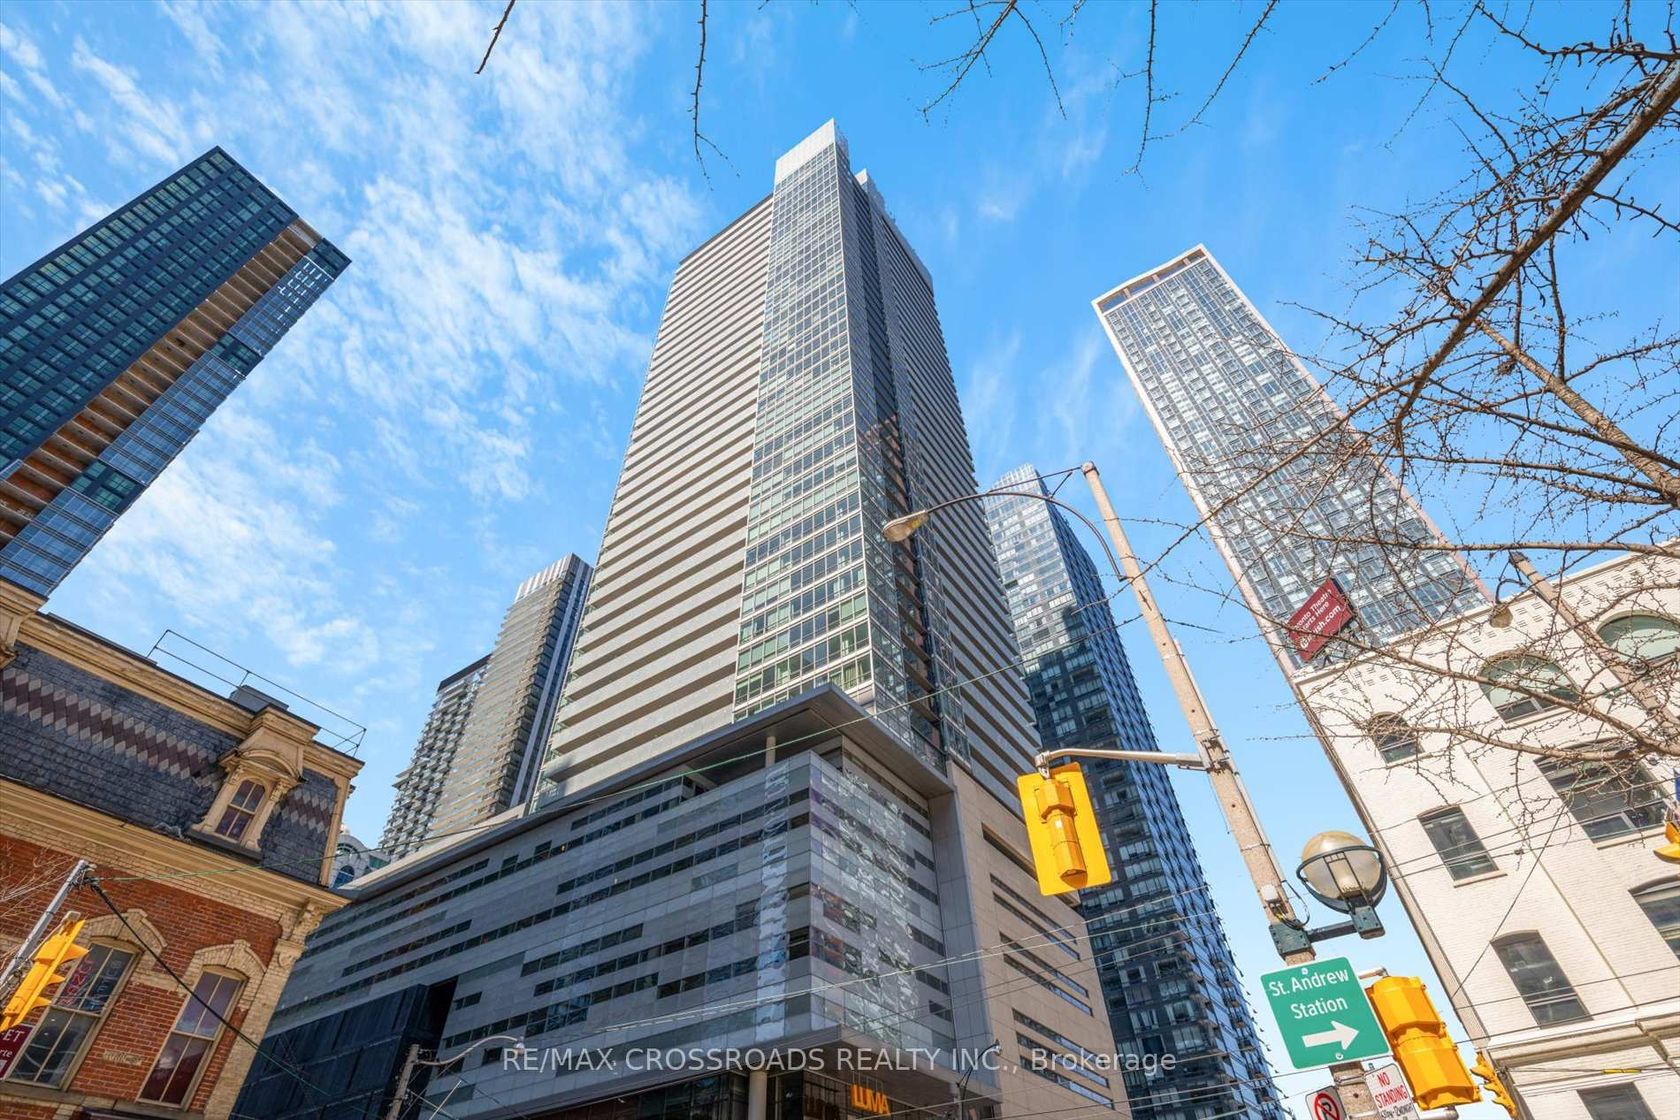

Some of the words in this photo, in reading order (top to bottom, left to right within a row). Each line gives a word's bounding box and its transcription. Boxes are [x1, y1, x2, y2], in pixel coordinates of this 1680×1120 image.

[1302, 615, 1317, 631] arts
[1314, 601, 1329, 617] Here
[1268, 981, 1290, 997] St.
[1291, 969, 1350, 993] Andrew
[1290, 997, 1349, 1019] Station
[1376, 1071, 1391, 1088] NO
[851, 1083, 890, 1115] LUMA
[1374, 1084, 1409, 1109] STANDING
